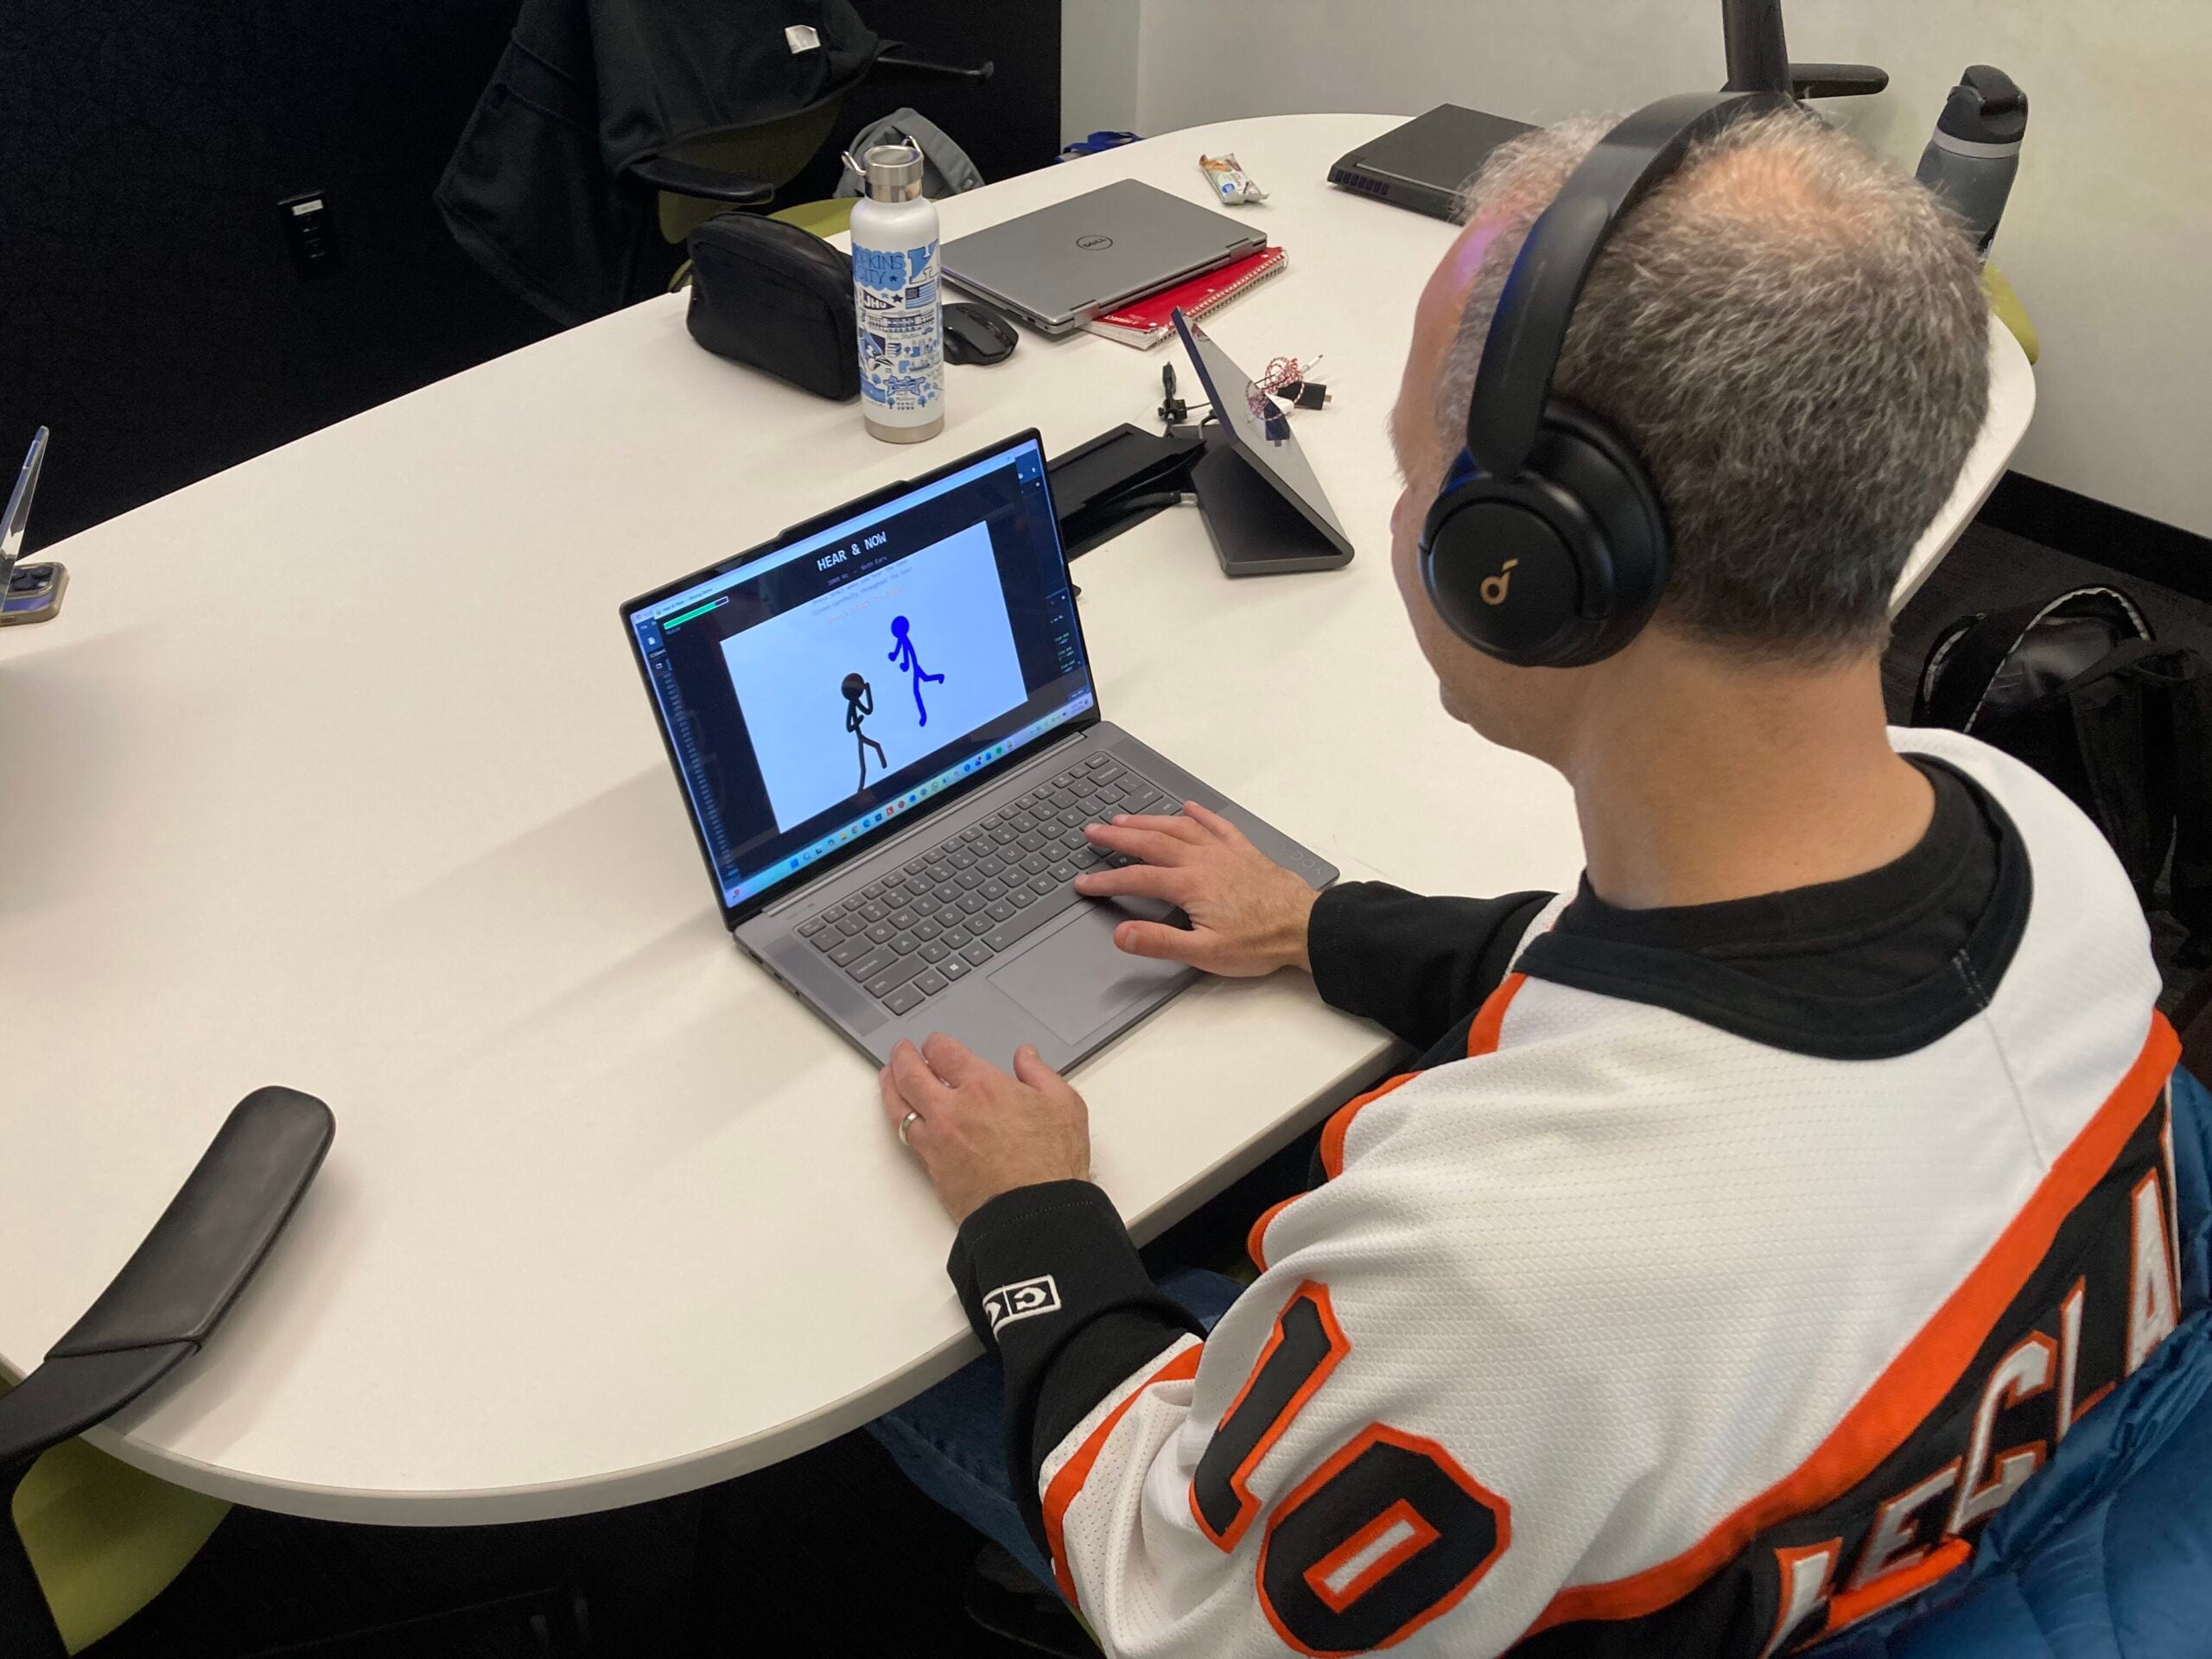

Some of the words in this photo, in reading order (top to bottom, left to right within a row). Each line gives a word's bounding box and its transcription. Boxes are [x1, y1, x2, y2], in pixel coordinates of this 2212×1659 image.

[1082, 238, 1107, 248] DELL
[854, 248, 903, 270] OPKINS
[817, 550, 848, 571] HEAR
[851, 543, 861, 556] &
[863, 531, 887, 550] NOW
[1188, 1280, 1511, 1658] 10
